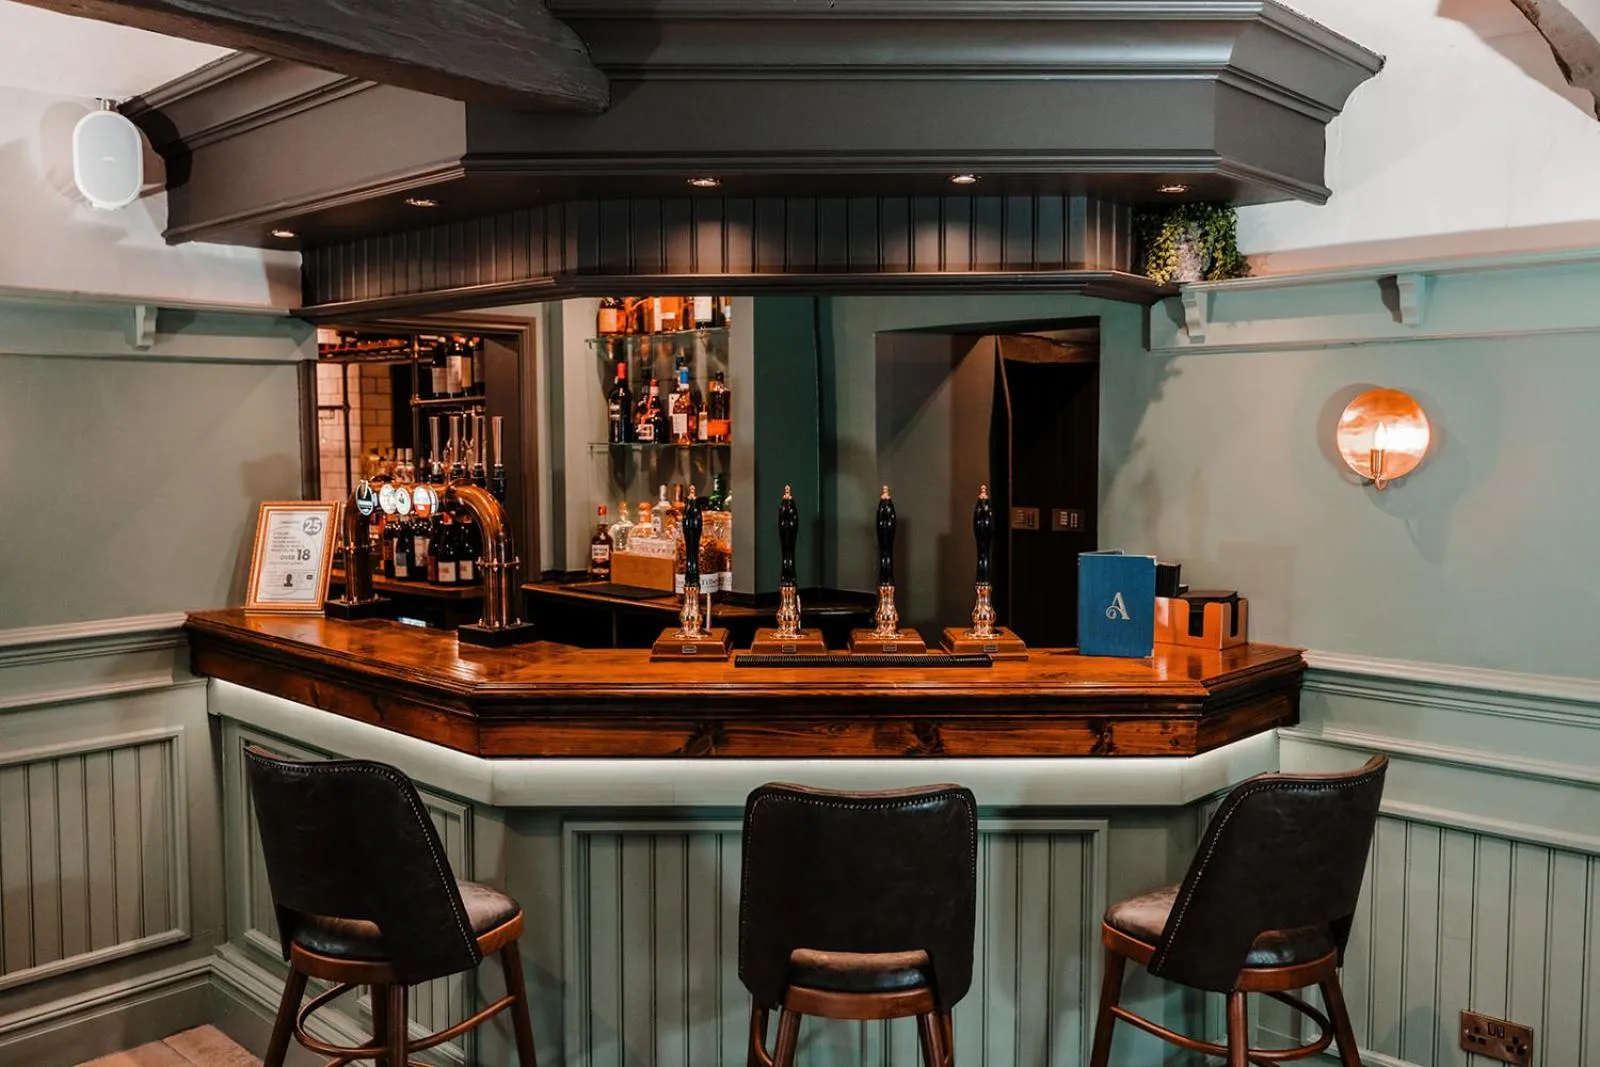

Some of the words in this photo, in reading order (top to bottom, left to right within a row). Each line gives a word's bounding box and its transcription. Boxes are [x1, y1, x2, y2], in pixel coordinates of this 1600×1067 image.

[305, 520, 322, 532] 25
[297, 548, 311, 561] 18
[1105, 592, 1131, 620] A
